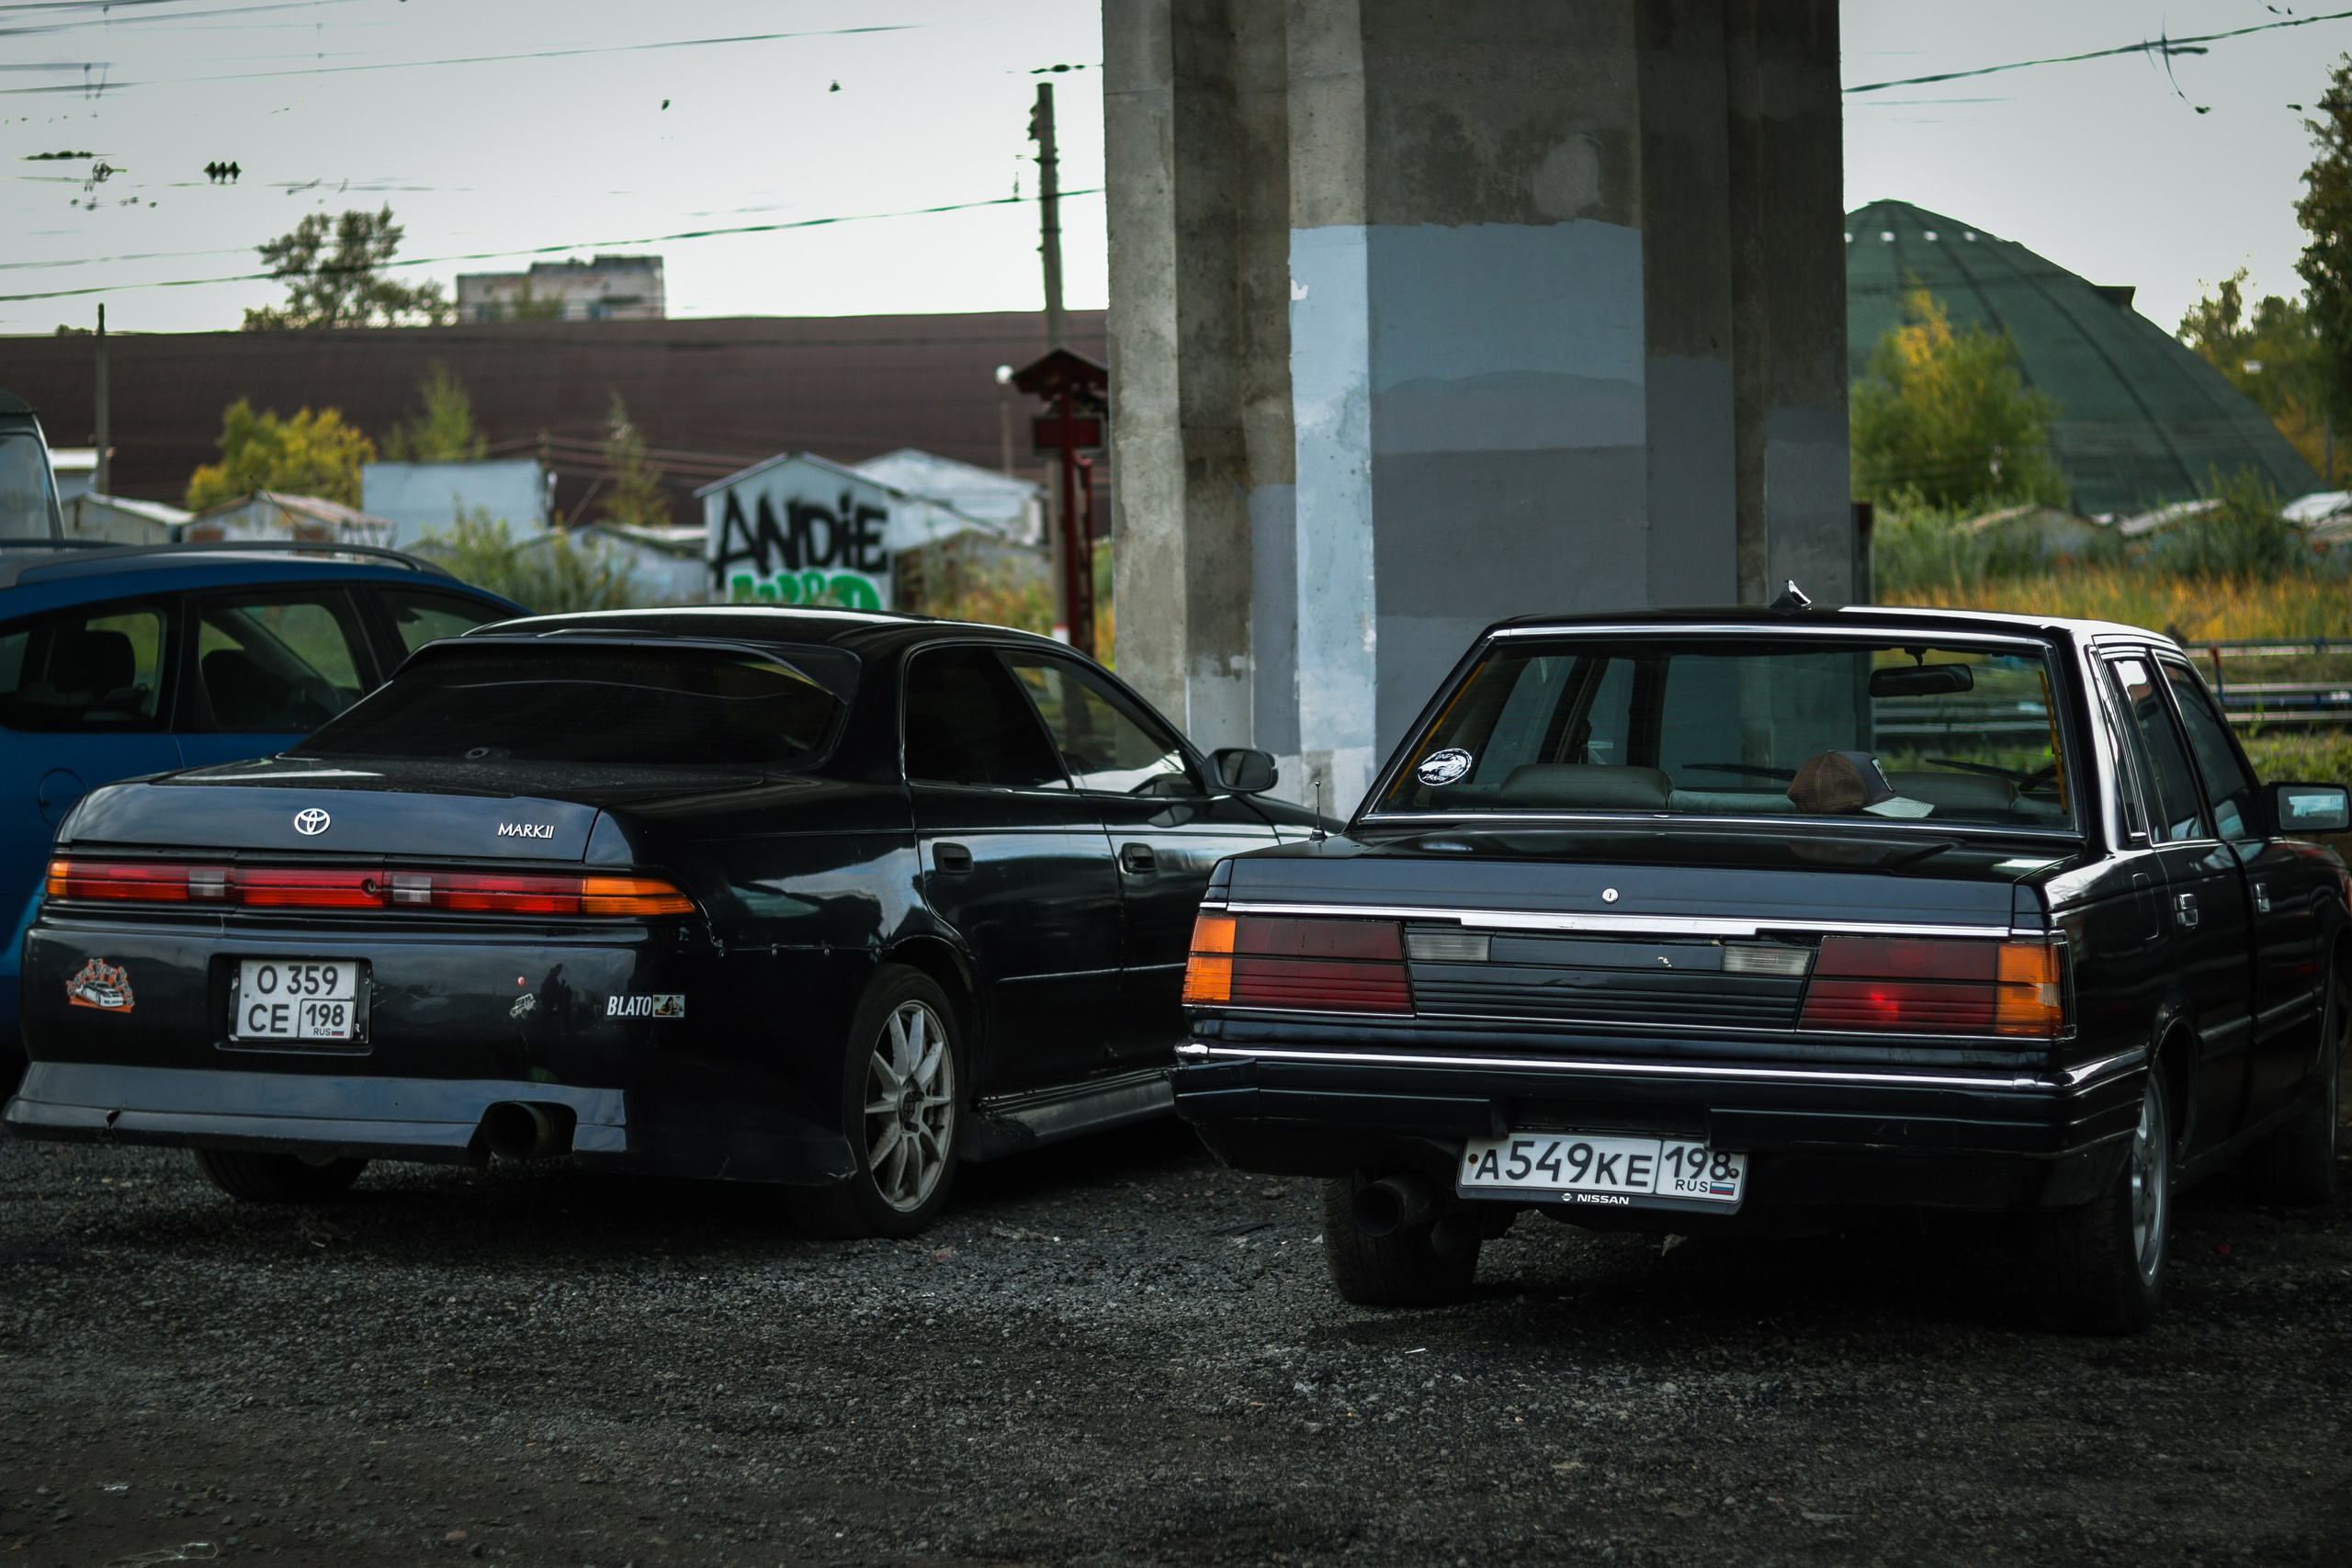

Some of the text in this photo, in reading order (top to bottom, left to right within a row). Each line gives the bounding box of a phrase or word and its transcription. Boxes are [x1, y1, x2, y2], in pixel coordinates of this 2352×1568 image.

[287, 965, 338, 996] 359
[606, 996, 652, 1016] BLATO
[248, 1003, 345, 1033] CE 198
[313, 1027, 331, 1036] RUS
[1475, 1141, 1731, 1187] A549KE 198
[1675, 1179, 1709, 1192] RUS
[1577, 1193, 1630, 1205] NISSAN
